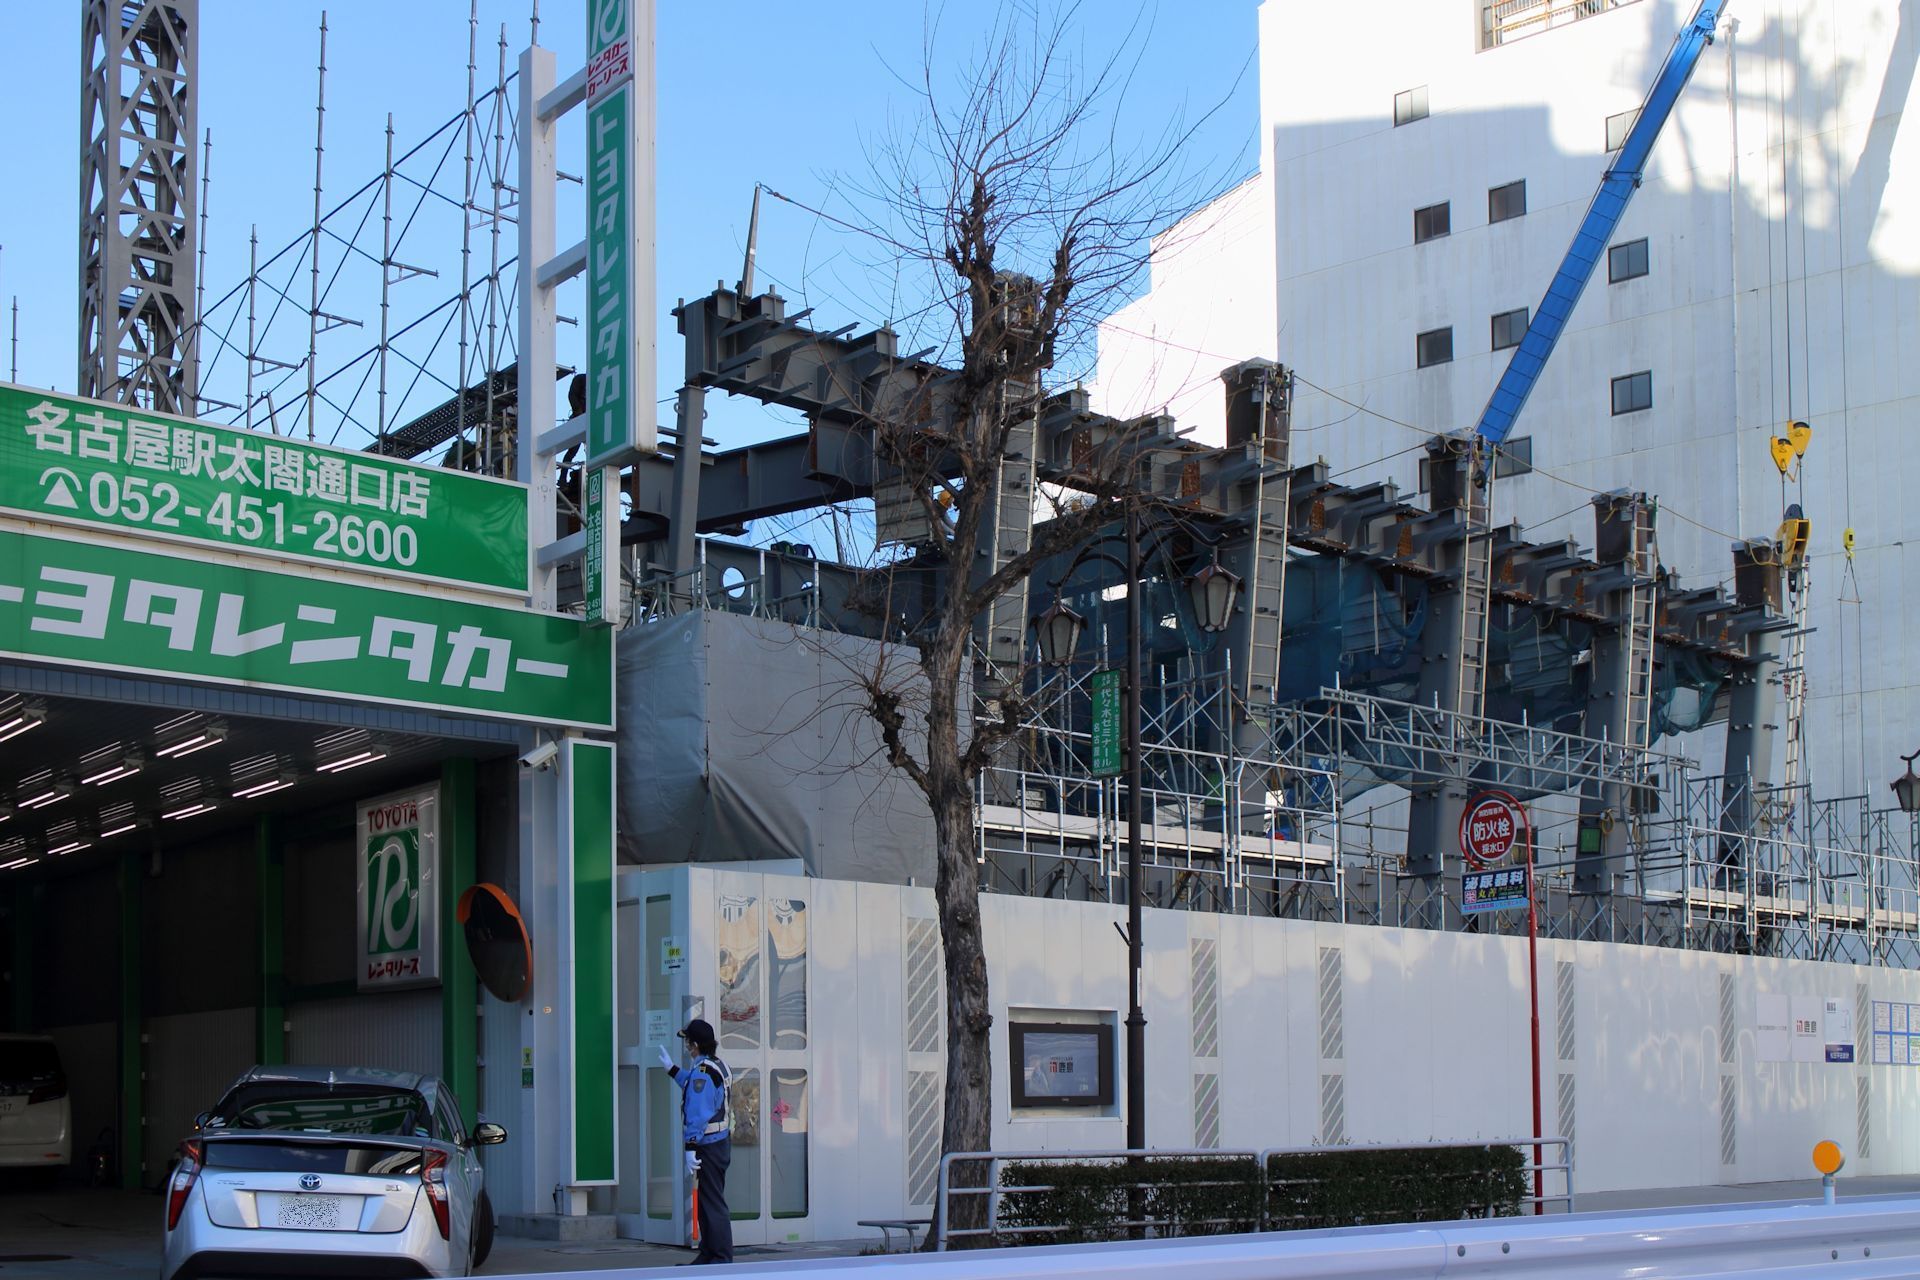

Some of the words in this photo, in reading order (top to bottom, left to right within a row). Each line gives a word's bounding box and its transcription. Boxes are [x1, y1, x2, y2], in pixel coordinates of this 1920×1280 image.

[588, 41, 628, 78] レンタカー
[588, 56, 628, 98] カーリース
[595, 113, 621, 444] トヨタレンタカー
[25, 400, 431, 519] 名古屋駅太閤通口店
[89, 471, 418, 567] 052-451-2600
[368, 801, 418, 834] TOYOTA
[1473, 818, 1511, 842] 防火栓
[1464, 870, 1524, 890] 泌尿器科
[368, 957, 420, 980] レンタリース
